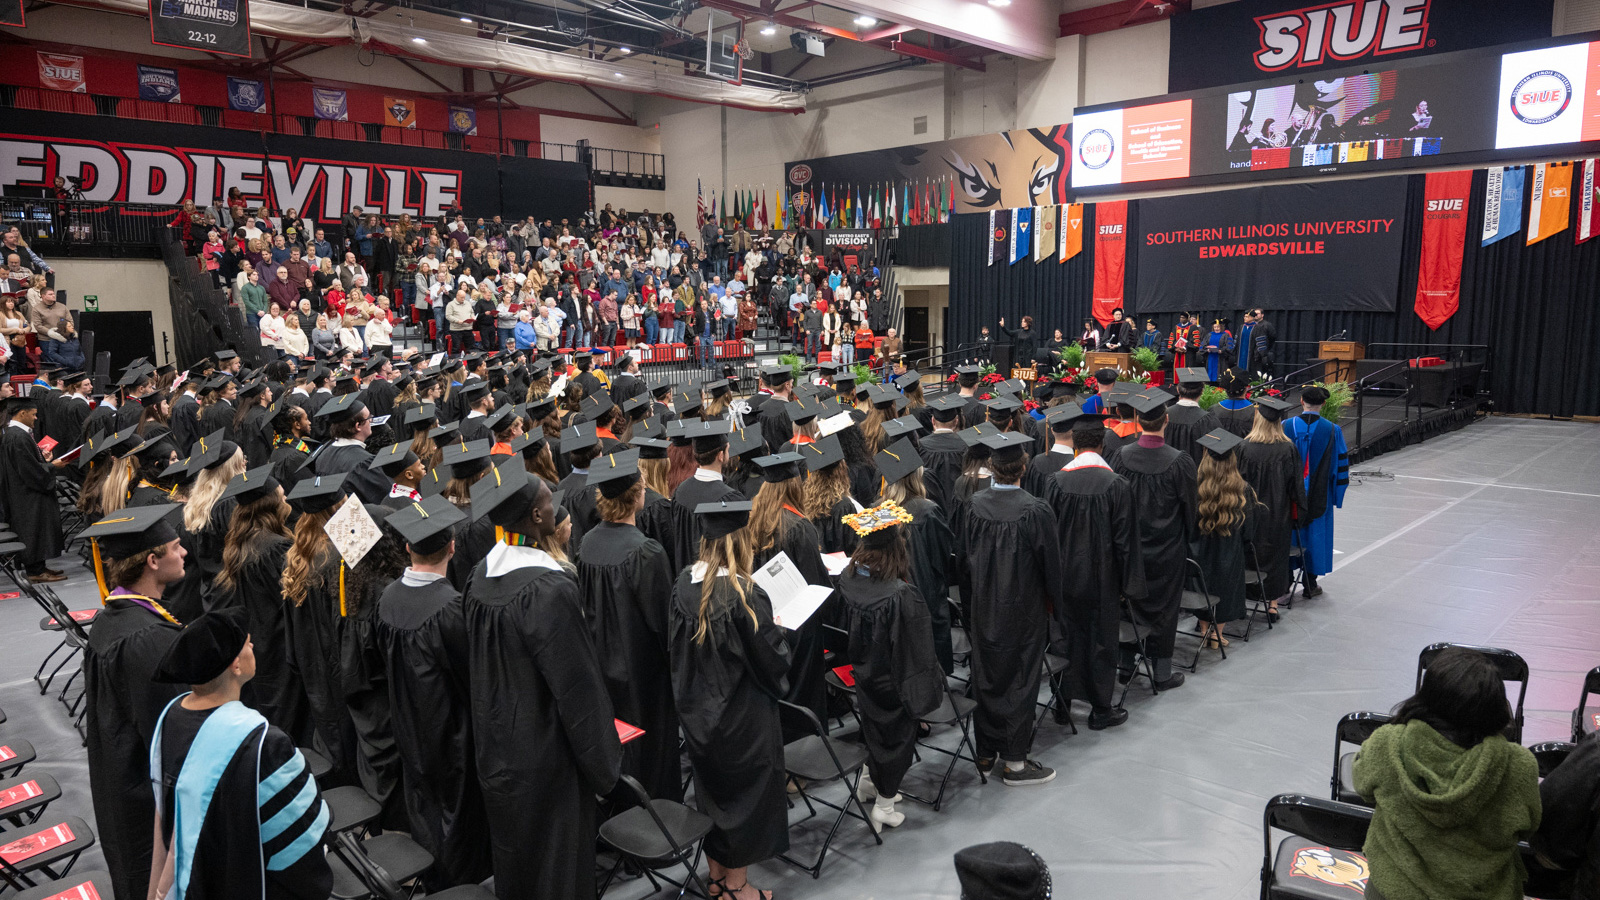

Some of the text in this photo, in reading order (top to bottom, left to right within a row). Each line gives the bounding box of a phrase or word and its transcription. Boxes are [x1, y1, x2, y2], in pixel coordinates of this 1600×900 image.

[184, 4, 236, 22] MADNESS
[188, 30, 216, 44] 22-12
[1255, 0, 1429, 70] SIUE
[44, 66, 80, 80] SIUE
[1521, 90, 1560, 104] SIUE
[1086, 144, 1108, 154] SIUE
[0, 140, 460, 218] EDDIEVILLE
[794, 170, 806, 179] OVC
[1494, 172, 1502, 202] BEHAVIOR
[1534, 170, 1544, 200] NURSING
[1584, 172, 1592, 211] PHARMACY
[1426, 198, 1464, 212] SIUE
[1099, 224, 1122, 234] SIUE
[1146, 218, 1394, 246] SOUTHERN ILLINOIS UNIVERSITY
[1199, 241, 1325, 259] EDWARDSVILLE
[1012, 370, 1036, 380] SIUE
